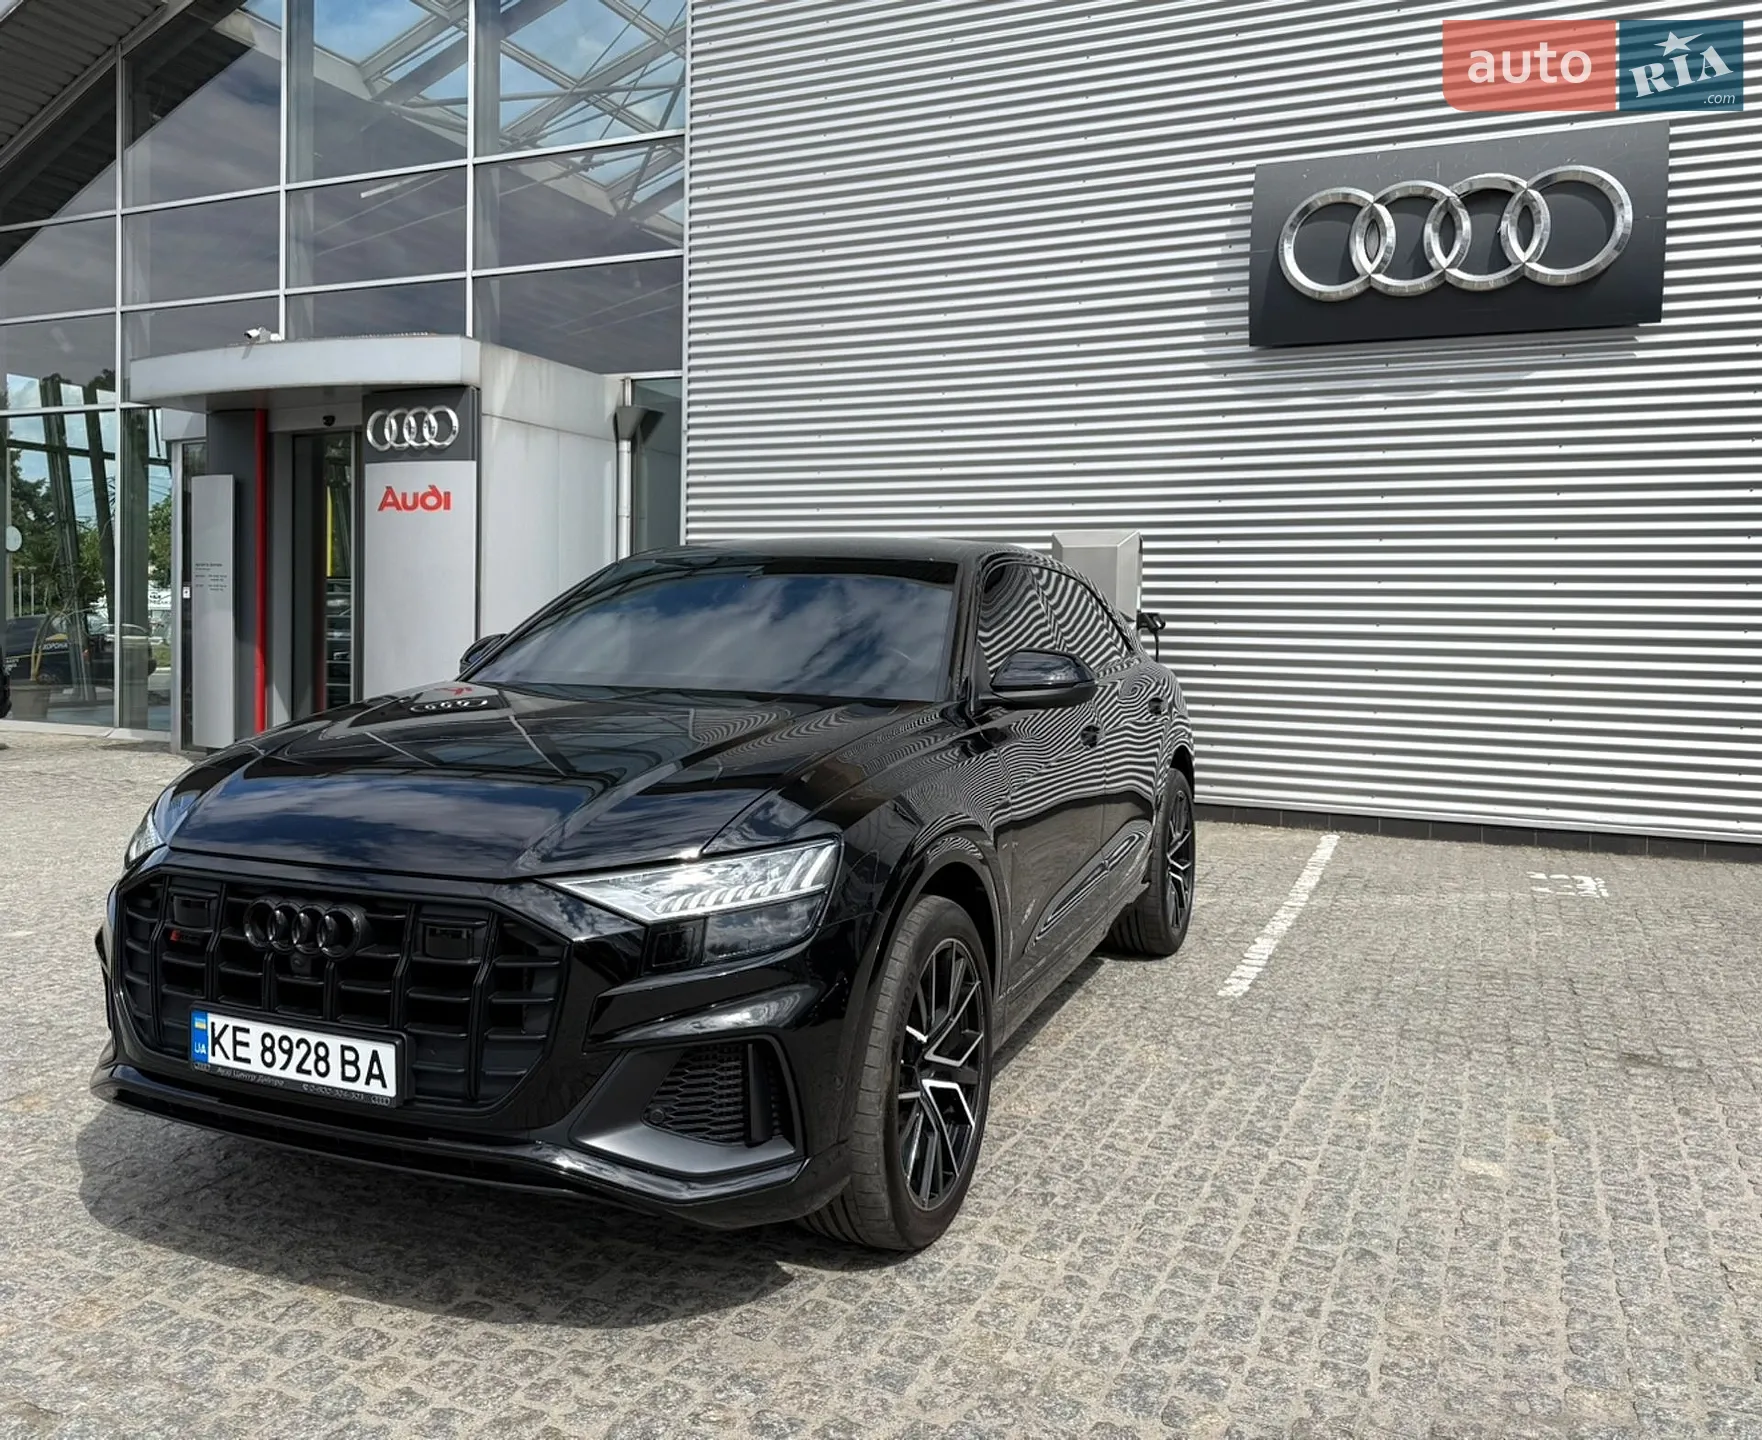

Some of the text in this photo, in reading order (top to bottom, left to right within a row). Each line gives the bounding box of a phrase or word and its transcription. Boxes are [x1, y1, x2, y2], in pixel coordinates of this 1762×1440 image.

[377, 484, 452, 511] Audi
[194, 1042, 207, 1056] UA
[210, 1021, 388, 1089] KE 8928 BA
